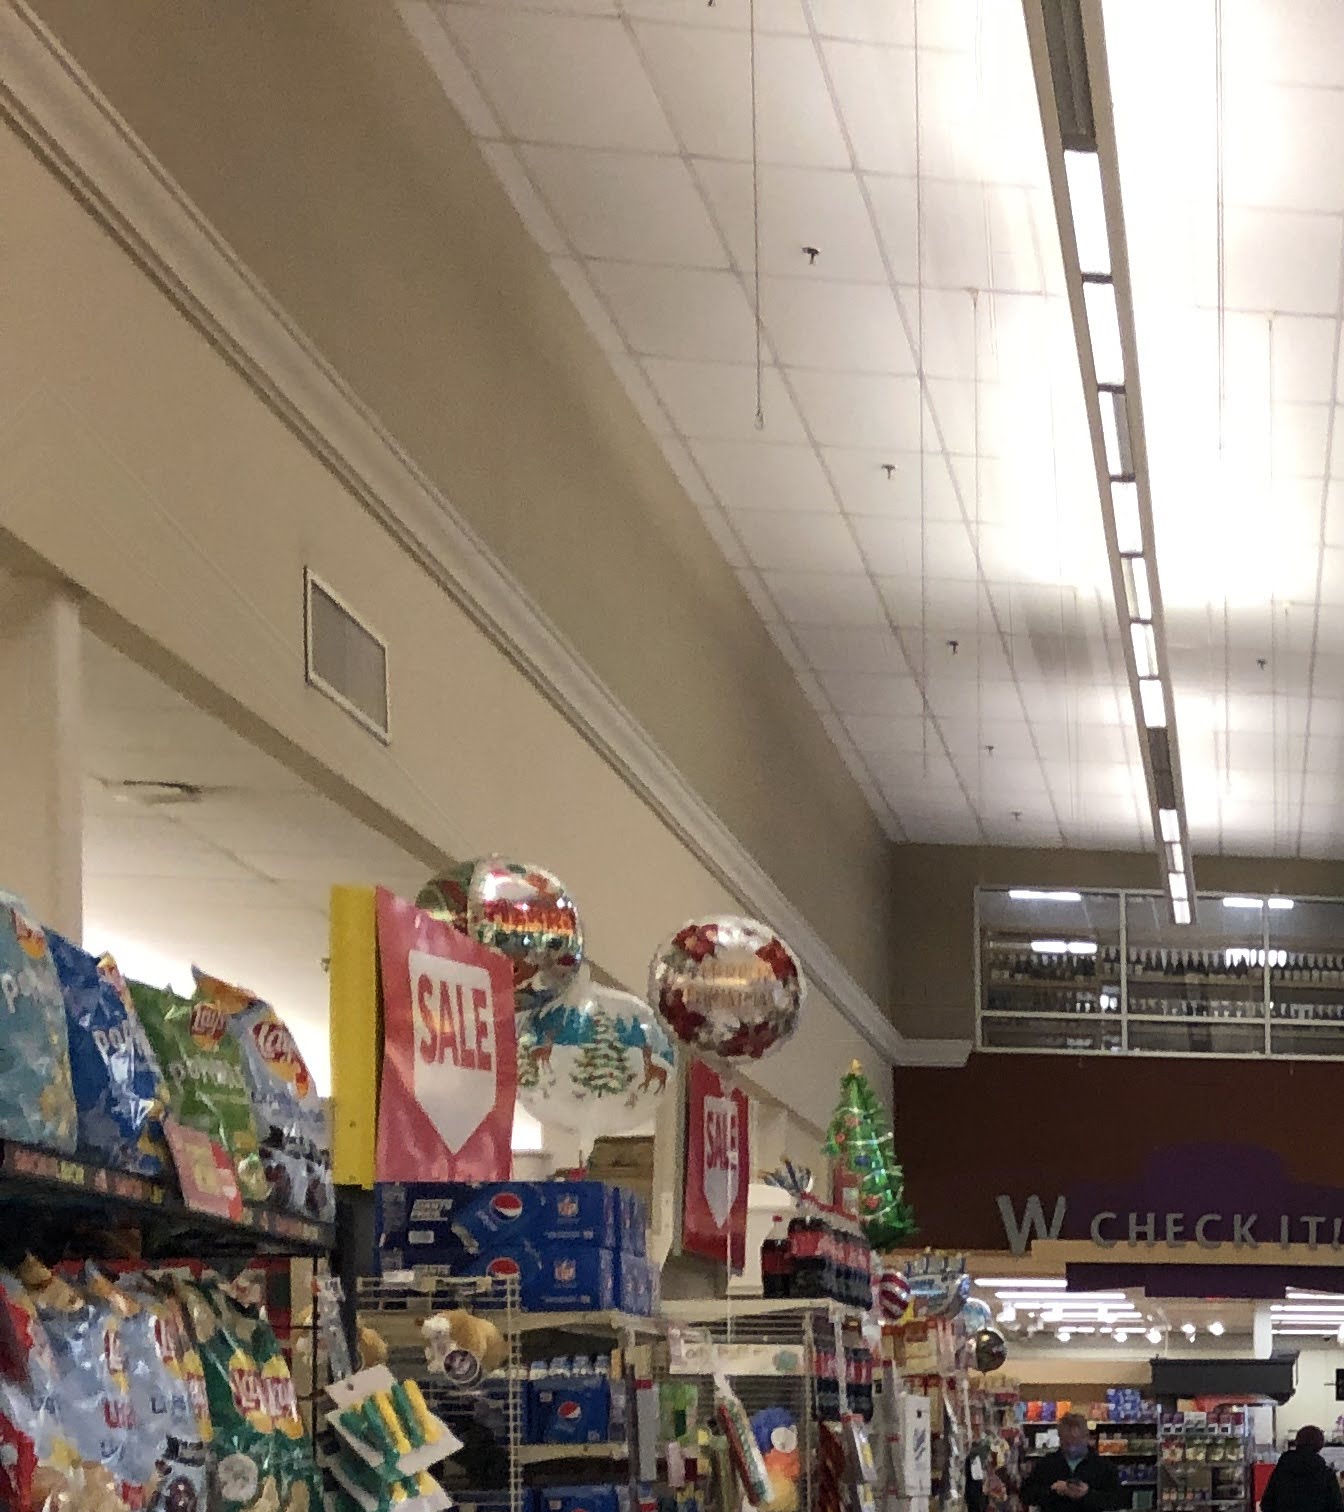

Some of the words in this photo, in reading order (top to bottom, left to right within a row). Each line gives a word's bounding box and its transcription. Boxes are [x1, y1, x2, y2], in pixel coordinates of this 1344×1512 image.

[416, 972, 493, 1073] SALE
[706, 1110, 737, 1171] SALE
[1090, 1211, 1260, 1249] CHECK
[1280, 1214, 1343, 1251] IT!
